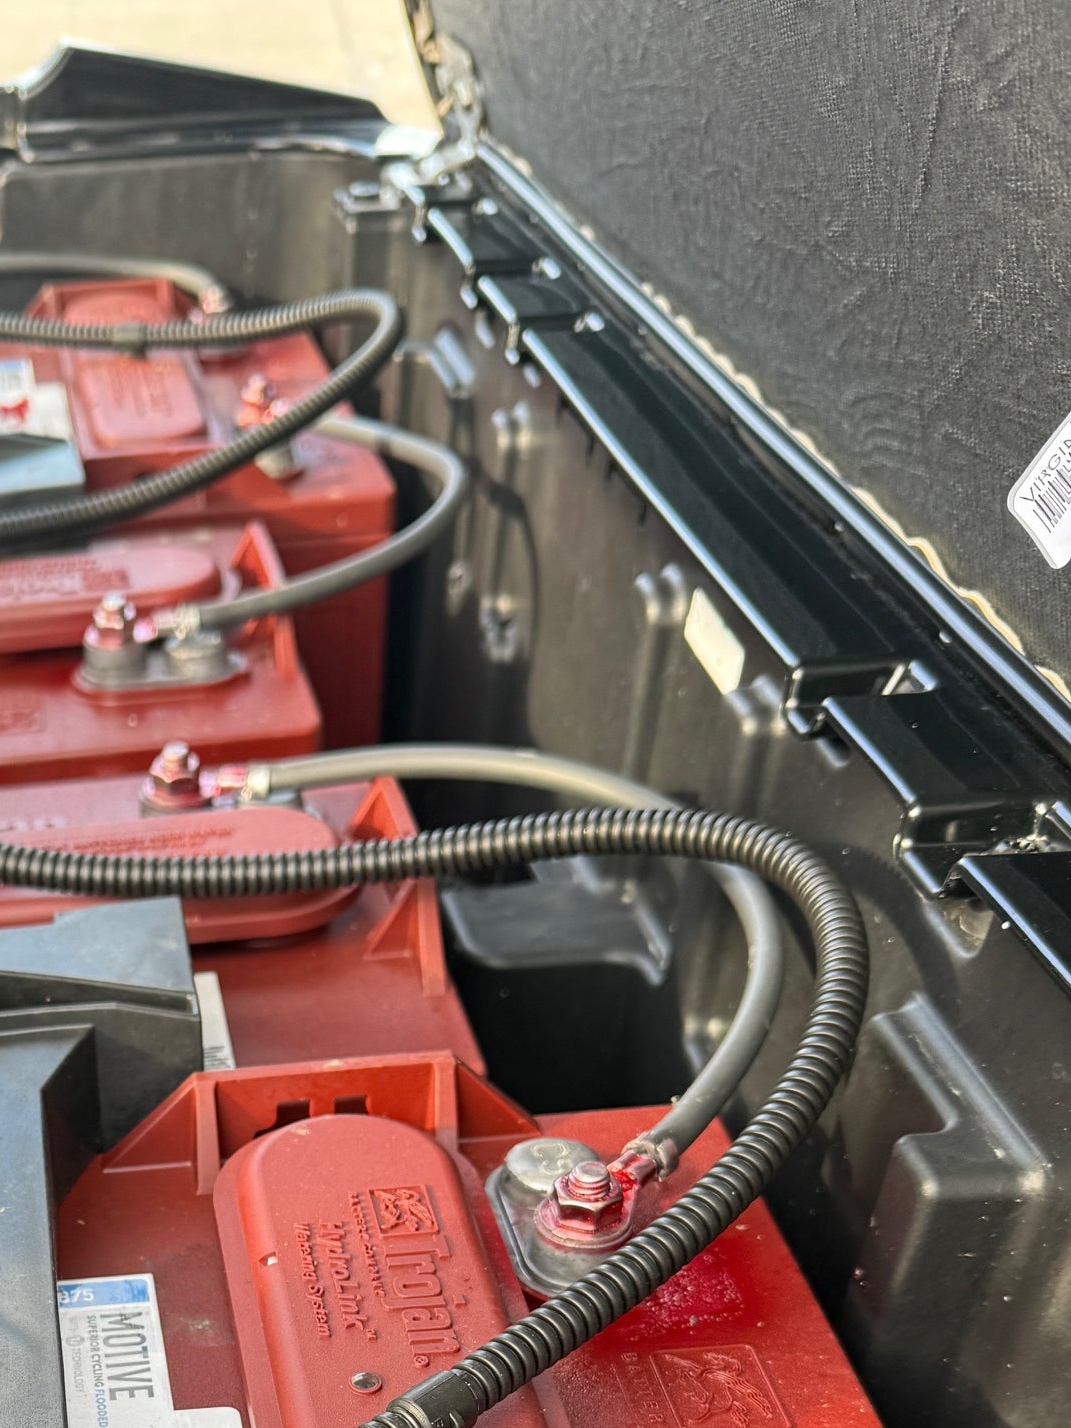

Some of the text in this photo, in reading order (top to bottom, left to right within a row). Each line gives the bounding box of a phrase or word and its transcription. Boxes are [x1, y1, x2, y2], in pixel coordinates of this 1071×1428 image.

[381, 1233, 466, 1356] Trojan
[87, 1315, 108, 1427] SUPERIOR CYCLING FLOODED
[100, 1312, 155, 1401] MOTIVE
